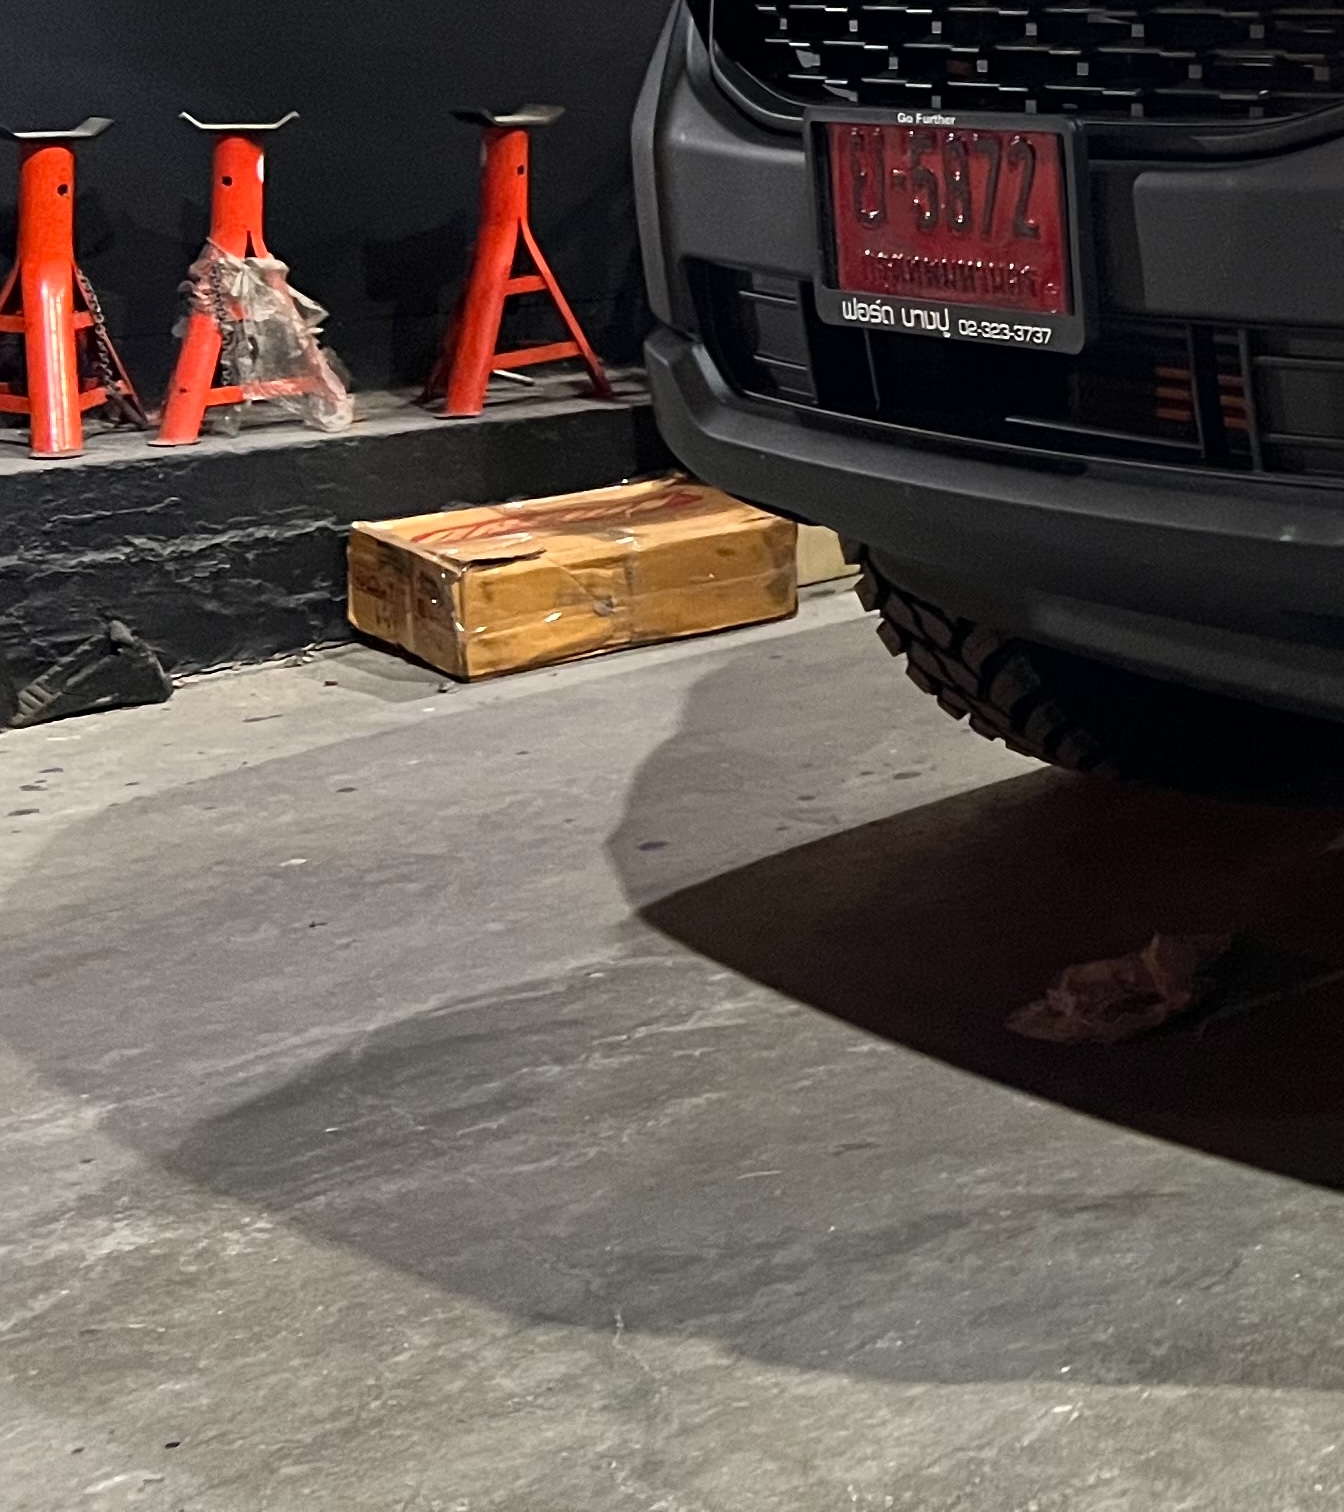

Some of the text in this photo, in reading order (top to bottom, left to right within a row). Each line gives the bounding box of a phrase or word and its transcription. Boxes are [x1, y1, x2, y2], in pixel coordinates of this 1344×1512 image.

[897, 112, 956, 126] Go Further
[842, 297, 1052, 345] ฟอร์ด บางปู 02-323-3737
